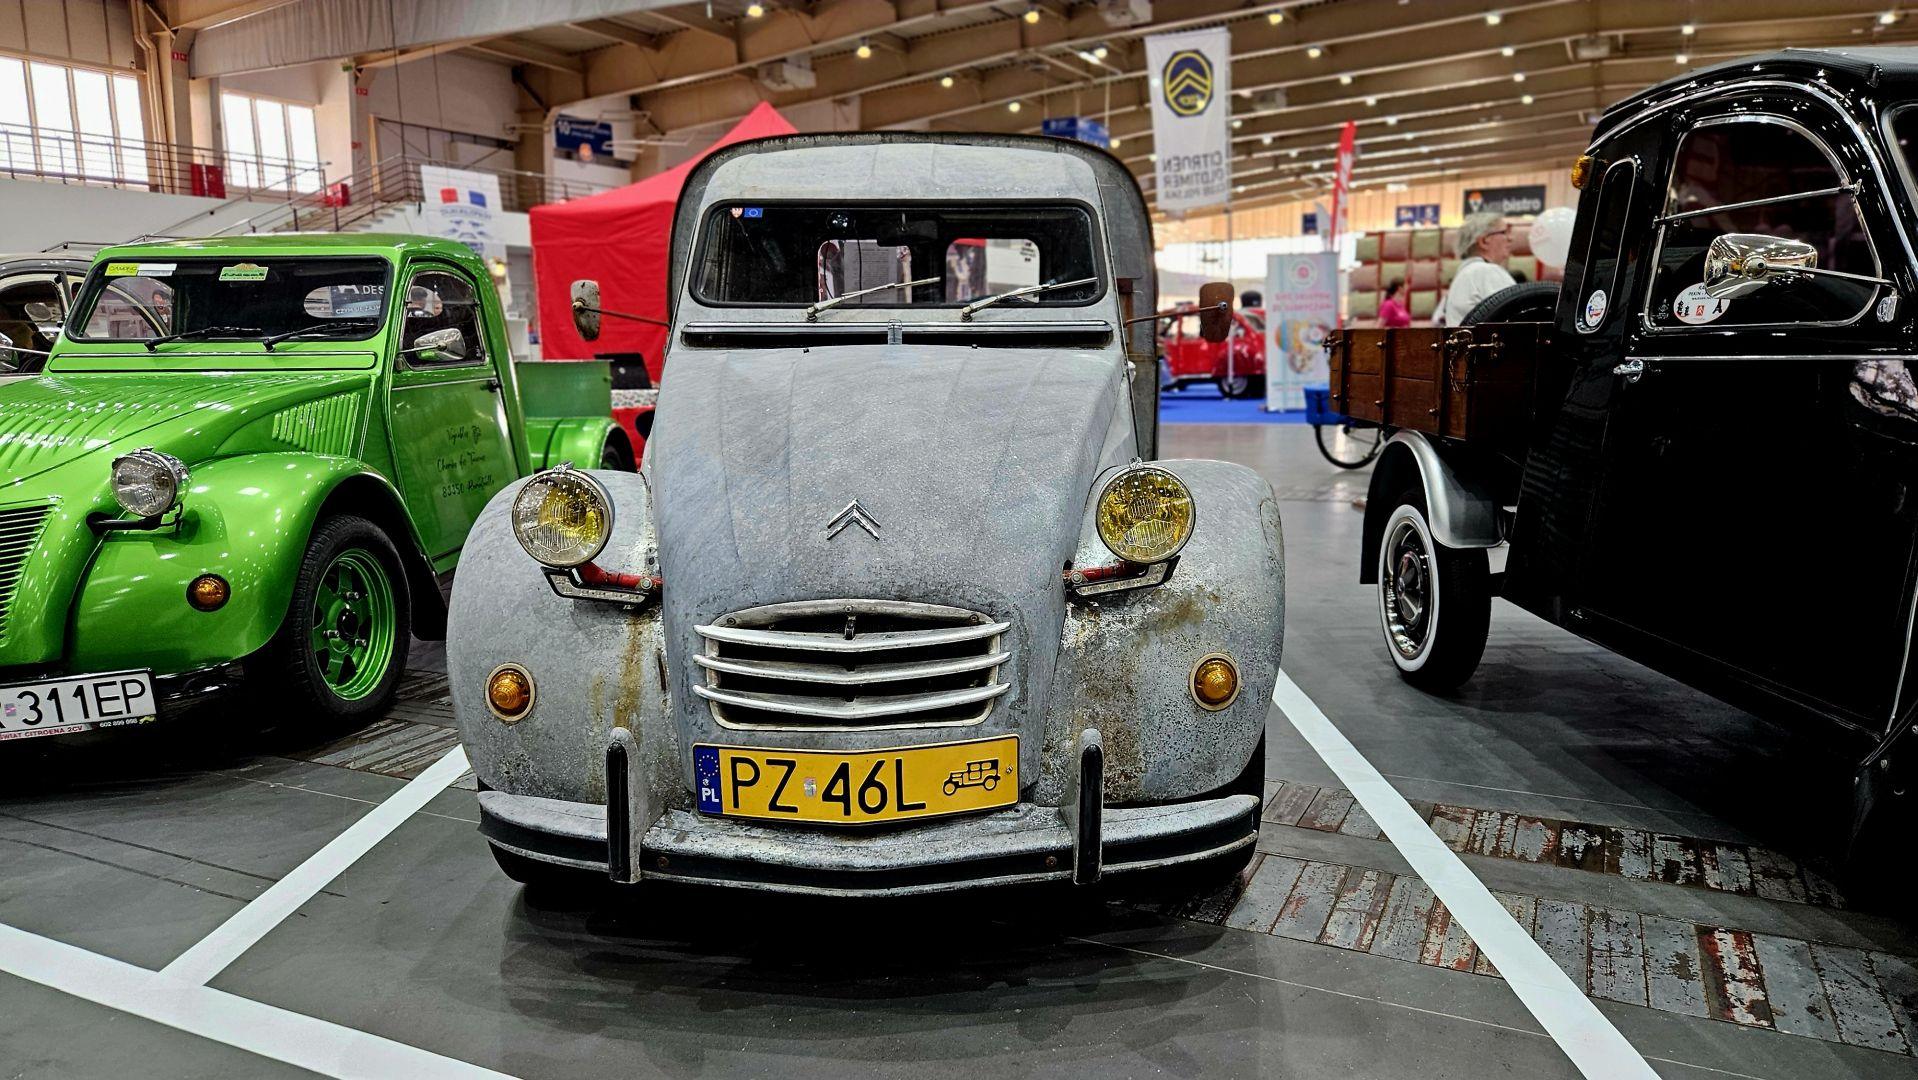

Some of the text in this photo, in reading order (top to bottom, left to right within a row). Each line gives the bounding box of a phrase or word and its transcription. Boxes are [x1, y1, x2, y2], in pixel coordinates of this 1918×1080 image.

[16, 678, 146, 726] 311EP
[24, 727, 65, 737] CITROENA
[67, 725, 83, 733] 2CV
[701, 787, 720, 803] PL
[730, 756, 927, 816] PZ 46L
